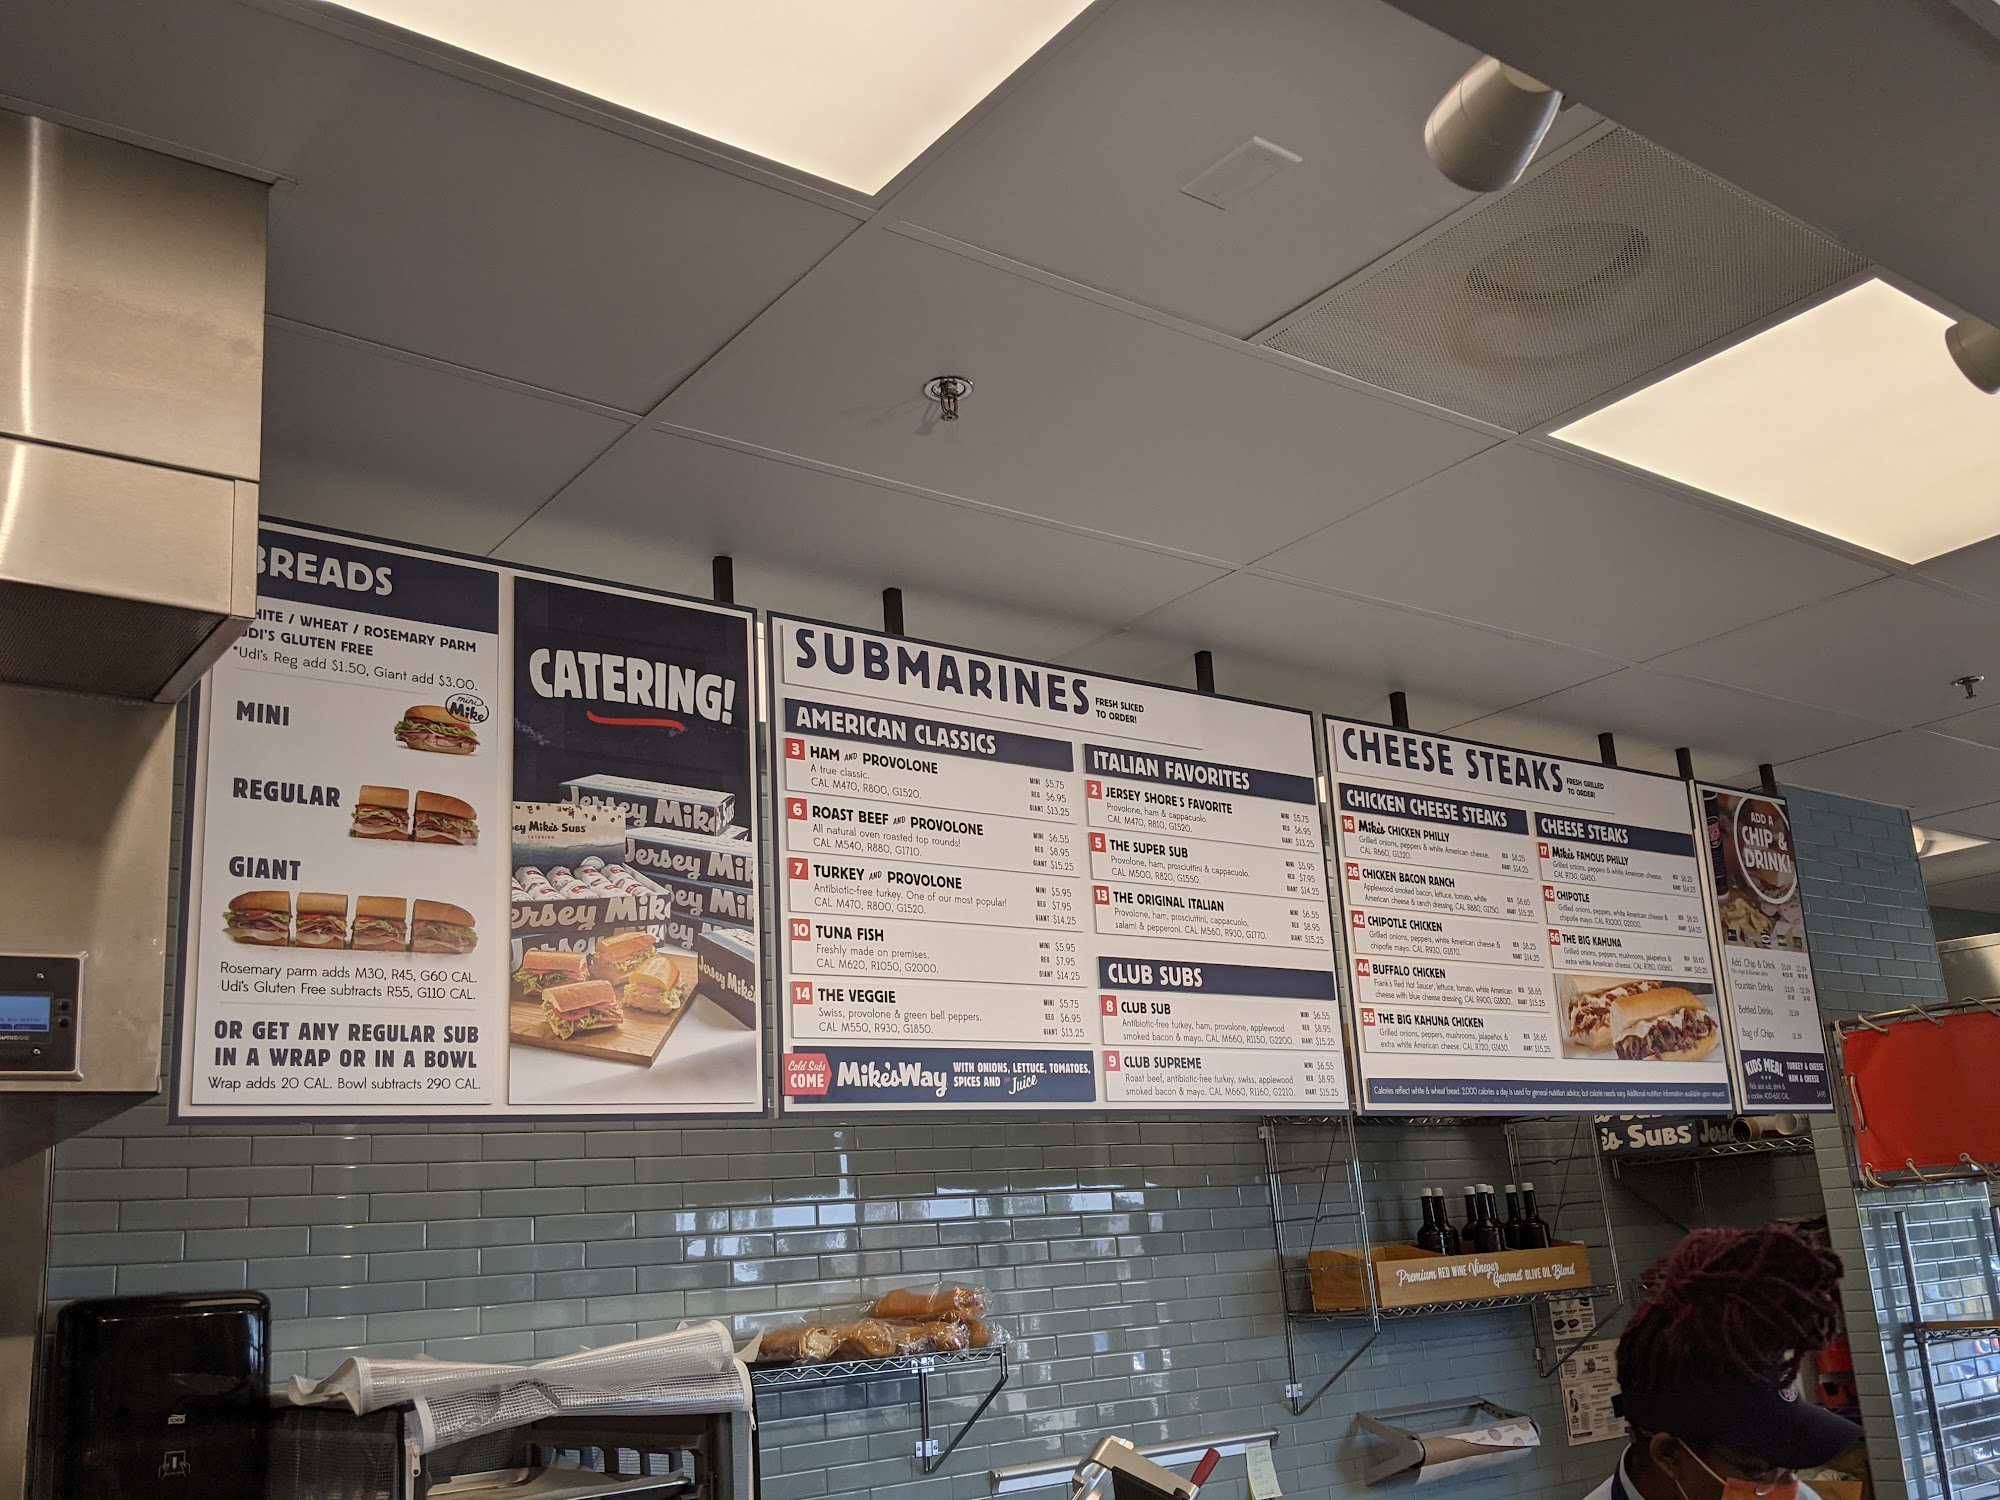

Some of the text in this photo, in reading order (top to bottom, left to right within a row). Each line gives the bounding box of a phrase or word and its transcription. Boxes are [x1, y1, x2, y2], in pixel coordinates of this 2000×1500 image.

[274, 651, 298, 669] Reg
[303, 655, 326, 669] add
[331, 659, 369, 677] $1.50,
[374, 666, 407, 681] Giant
[412, 671, 434, 685] add
[438, 675, 477, 691] $3.00.
[796, 628, 1089, 714] SUBMARINES
[529, 648, 736, 724] CATERING!
[236, 700, 290, 726] MINI
[450, 702, 484, 722] Mike
[1095, 698, 1144, 713] FRESH SLICED
[1096, 710, 1137, 724] TO ORDER!
[796, 706, 997, 755] AMERICAN CLASSICS
[791, 742, 938, 774] 3 HAM AND PROVOLONE
[1343, 728, 1563, 793] CHEESE STEAKS
[810, 765, 870, 779] A true classic.
[1093, 750, 1250, 790] ITALIAN FAVORITES
[232, 777, 340, 807] REGULAR
[811, 778, 922, 799] CAL M470, R800, G1520.
[1046, 778, 1065, 790] $5.75
[1567, 778, 1604, 790] FRESH GRILLED
[1576, 789, 1596, 798] ORDER!
[1046, 792, 1067, 803] $6.95
[1092, 784, 1233, 814] 2 JERSEY SHORE'S FAVORITE
[792, 803, 983, 836] 6 ROAST BEEF AND PROVOLONE
[1047, 806, 1070, 817] $13.25
[1346, 790, 1508, 828] CHICKEN CHEESE STEAKS
[1751, 812, 1774, 826] ADD A
[529, 821, 586, 833] Mike's SUBS
[1344, 820, 1450, 843] 16 Mike's CHICKEN PHILLY
[1541, 818, 1629, 844] CHEESE STEAKS
[1094, 838, 1189, 858] 5 THE SUPER SUB
[1742, 826, 1773, 848] CHIP
[1778, 832, 1788, 851] &
[1540, 846, 1629, 866] 17 Mike's FAMOUS PHILLY
[1744, 848, 1792, 873] DRINK!
[230, 856, 301, 880] GIANT
[794, 863, 962, 889] 7 TURKEY AND PROVOLONE
[1348, 866, 1455, 887] 26 CHICKEN BACON RANCH
[1096, 890, 1224, 912] 13 THE ORIGINAL ITALIAN
[792, 924, 884, 942] 10 TUNA FISH
[220, 962, 477, 983] Rosemary parm adds M30, R45, G60 CAL.
[698, 955, 726, 989] Jersey
[1108, 963, 1203, 987] CLUB SUBS
[796, 986, 896, 1004] 14 THE VEGGIE
[1106, 1000, 1171, 1014] 8 CLUB SUB
[215, 1020, 479, 1043] OR GET ANY REGULAR SUB
[1742, 1028, 1775, 1040] Bag of Chips
[215, 1048, 477, 1068] IN A WRAP OR IN A BOWL
[788, 1060, 826, 1072] Cold Subs
[953, 1062, 1091, 1075] WITH ONIONS, LETTUCE, TOMATOES,
[1108, 1056, 1202, 1069] 9 CLUB SUPREME
[1745, 1058, 1784, 1077] KIDS MEAL
[790, 1074, 825, 1088] COME
[953, 1076, 980, 1087] SPICES
[984, 1076, 1000, 1087] AND
[1008, 1075, 1038, 1095] Juice
[1629, 1123, 1692, 1149] SUBS
[1396, 1258, 1499, 1286] Premium RED WINE Vinegar
[1492, 1263, 1575, 1288] Gourmet OLIVE OIL Blend
